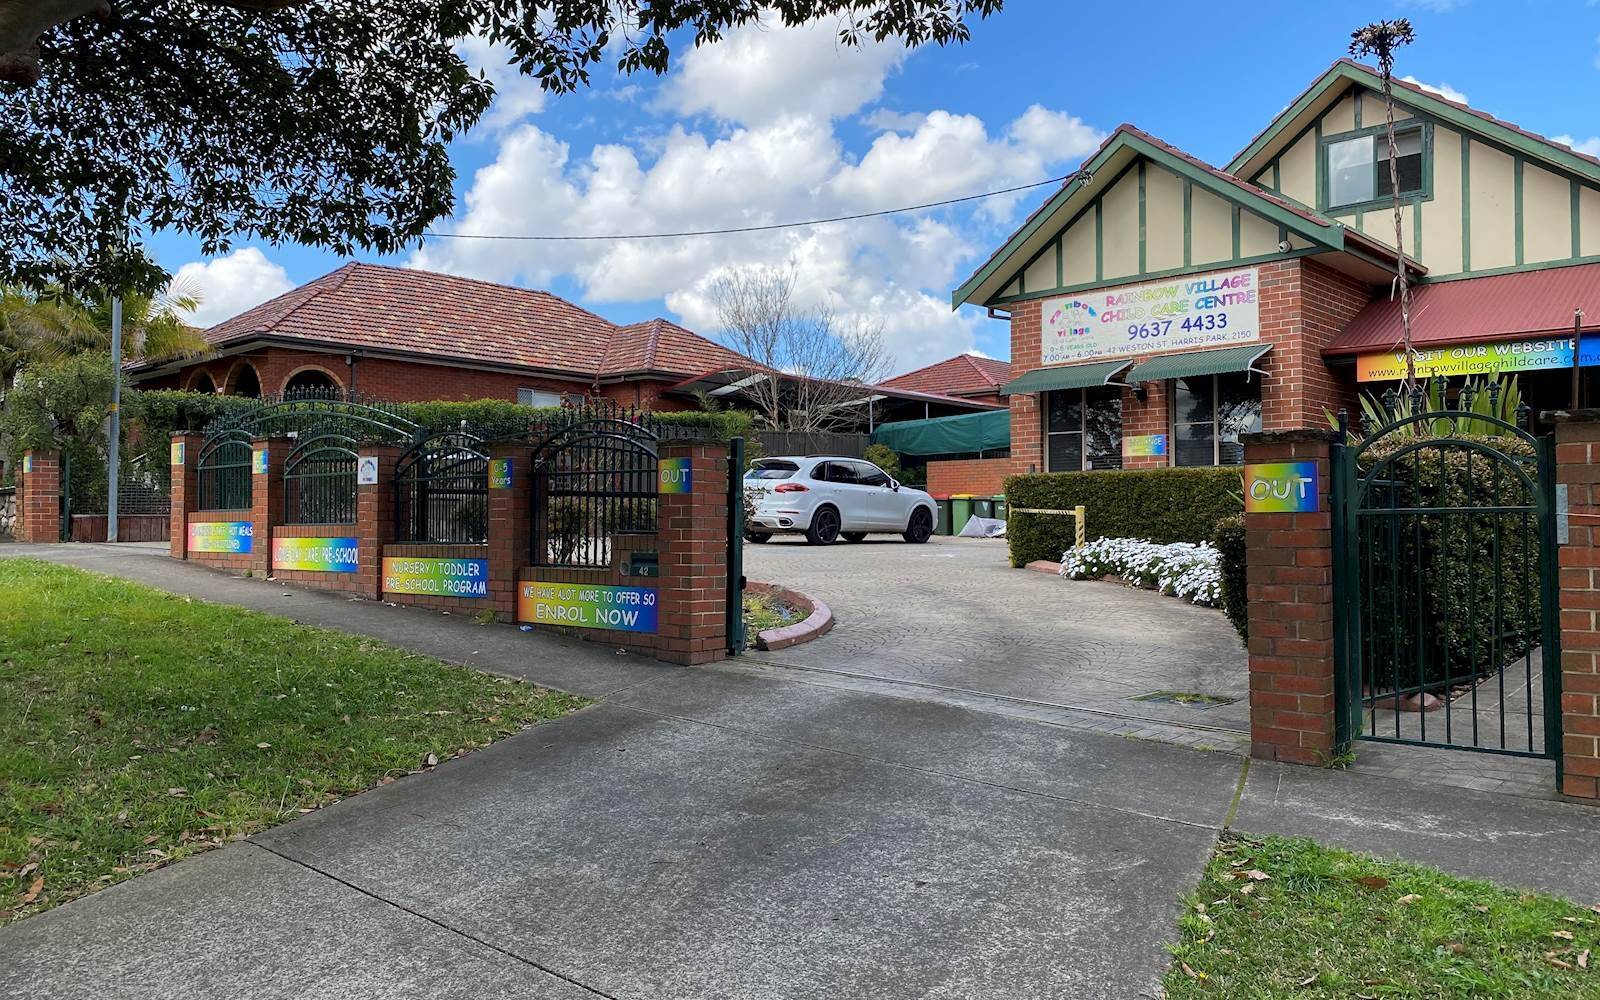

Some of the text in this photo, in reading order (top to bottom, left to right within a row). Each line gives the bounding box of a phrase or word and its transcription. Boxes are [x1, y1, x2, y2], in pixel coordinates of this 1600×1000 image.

[1106, 273, 1251, 307] RAINBOW VILLAGE
[1101, 290, 1257, 323] CHILD CARE CENTRE
[1128, 313, 1228, 340] 9637 4433
[1119, 342, 1154, 353] WESTON
[1171, 337, 1203, 346] HARRIS
[1232, 330, 1251, 339] 2150
[1394, 338, 1576, 364] VSIT OUR WEBSITE
[1368, 354, 1600, 377] www.rinbowvillagechildcare.cm.
[491, 476, 511, 485] Years
[660, 468, 688, 483] OUT
[1250, 477, 1313, 500] OUT
[438, 562, 480, 576] TODDLER
[638, 566, 649, 576] 42
[386, 577, 487, 594] PRE-SCHOOL PROGRAM
[523, 586, 655, 606] WE HAVE ALOT MORE TO OFFER SO
[536, 603, 639, 627] ENROL NOW
